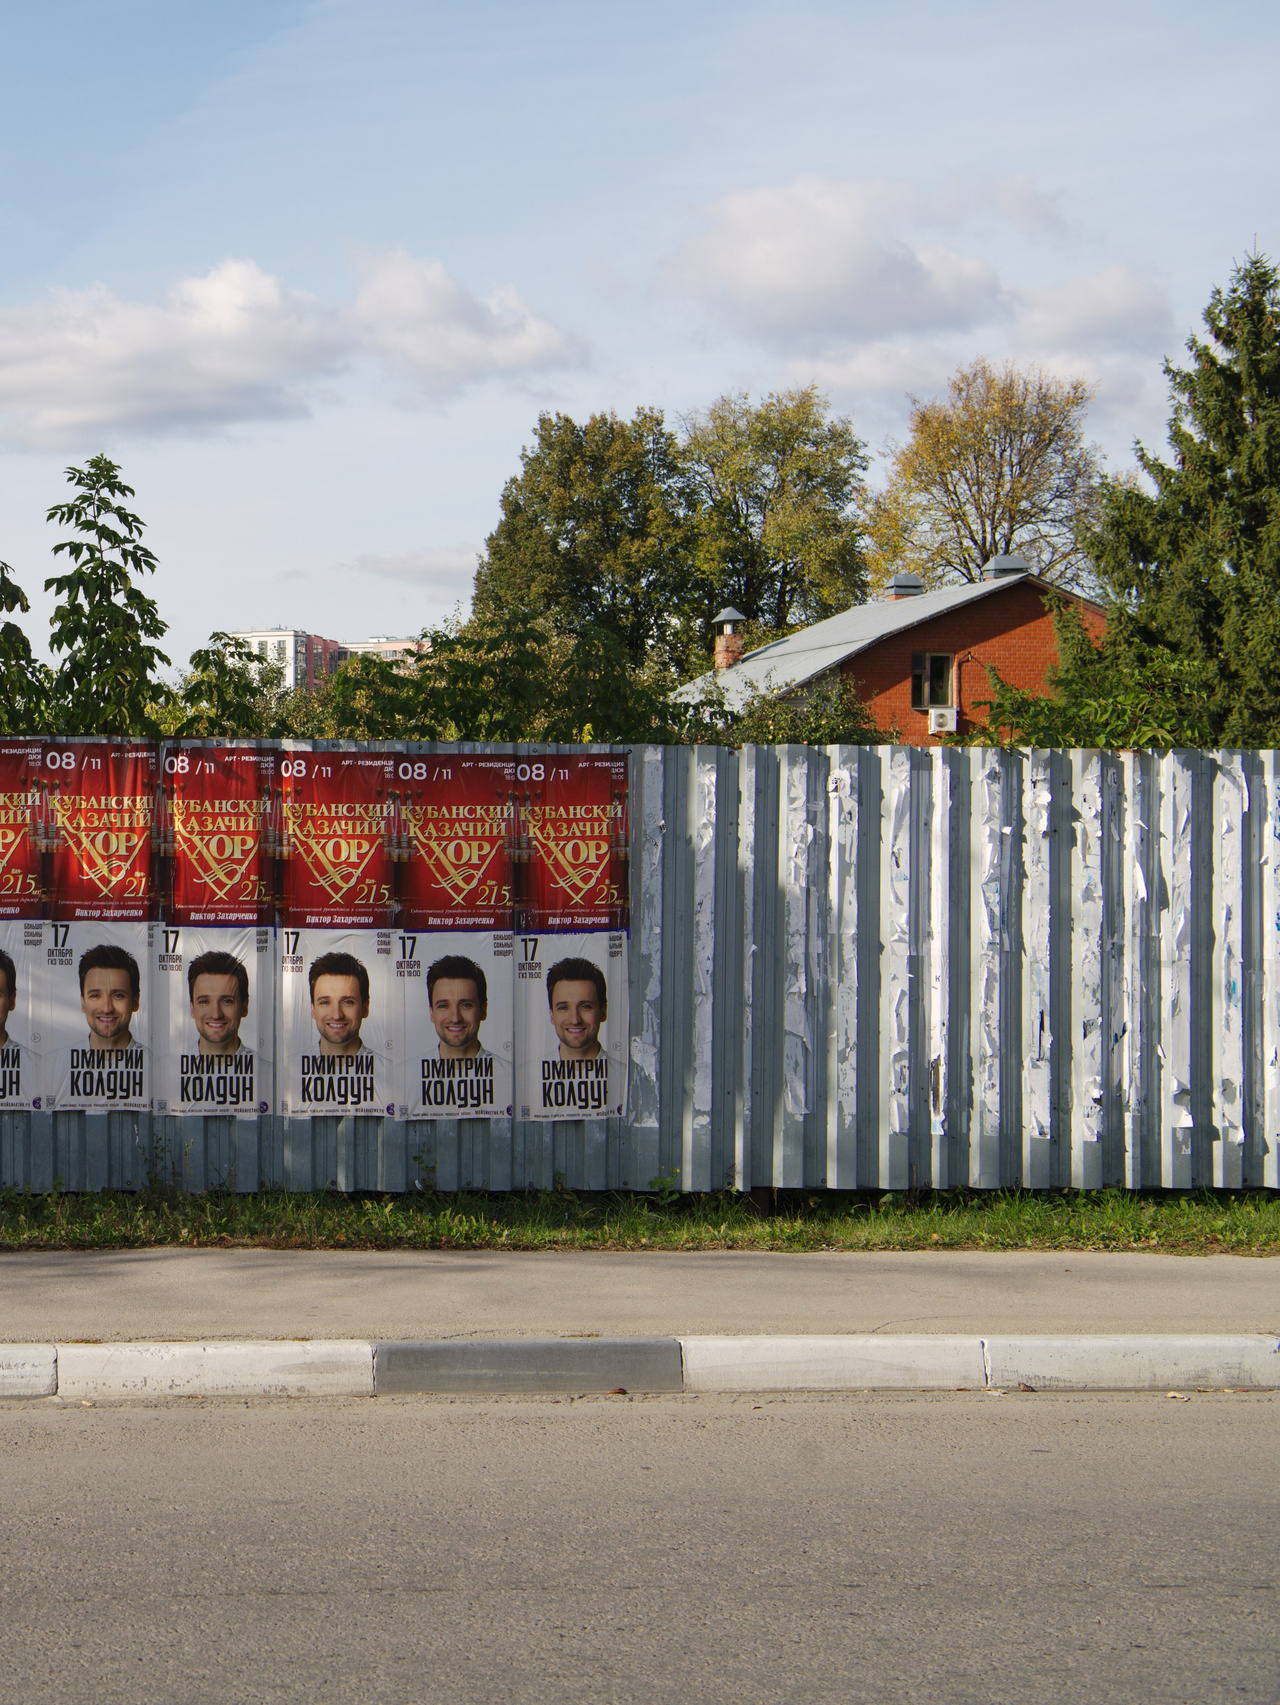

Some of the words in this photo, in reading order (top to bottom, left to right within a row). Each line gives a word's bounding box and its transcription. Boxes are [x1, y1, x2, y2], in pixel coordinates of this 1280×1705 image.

[46, 752, 75, 770] 08
[165, 756, 190, 774] 08
[281, 760, 306, 778] 08
[398, 763, 427, 780] 08
[517, 763, 545, 781] 08
[283, 801, 395, 819] КУБАНСКИЙ
[401, 802, 515, 821] КУБАНСКИЙ
[288, 818, 387, 840] КАЗАЧИЙ
[408, 819, 507, 841] КАЗАЧИЙ
[75, 831, 139, 861] ХОР
[188, 834, 254, 864] ХОР
[305, 838, 370, 868] ХОР
[426, 840, 491, 870] ХОР
[545, 840, 609, 870] ХОР
[1, 875, 37, 894] 215
[354, 884, 391, 904] 215
[476, 886, 512, 906] 215
[75, 908, 100, 917] Виктор
[102, 908, 143, 917] Захарченко
[190, 912, 216, 920] Виктор
[217, 912, 257, 920] Захарченко
[306, 915, 331, 924] Виктор
[332, 915, 373, 924] Захарченко
[428, 917, 454, 925] Виктор
[455, 917, 495, 925] Захарченко
[548, 916, 572, 925] Виктор
[52, 924, 70, 948] 17
[162, 930, 180, 953] 17
[284, 931, 300, 955] 17
[48, 949, 73, 957] ОКТЯБРЯ
[399, 936, 416, 960] 17
[521, 938, 539, 962] 17
[158, 955, 182, 963] ОКТЯБРЯ
[396, 961, 421, 970] ОКТЯБРЯ
